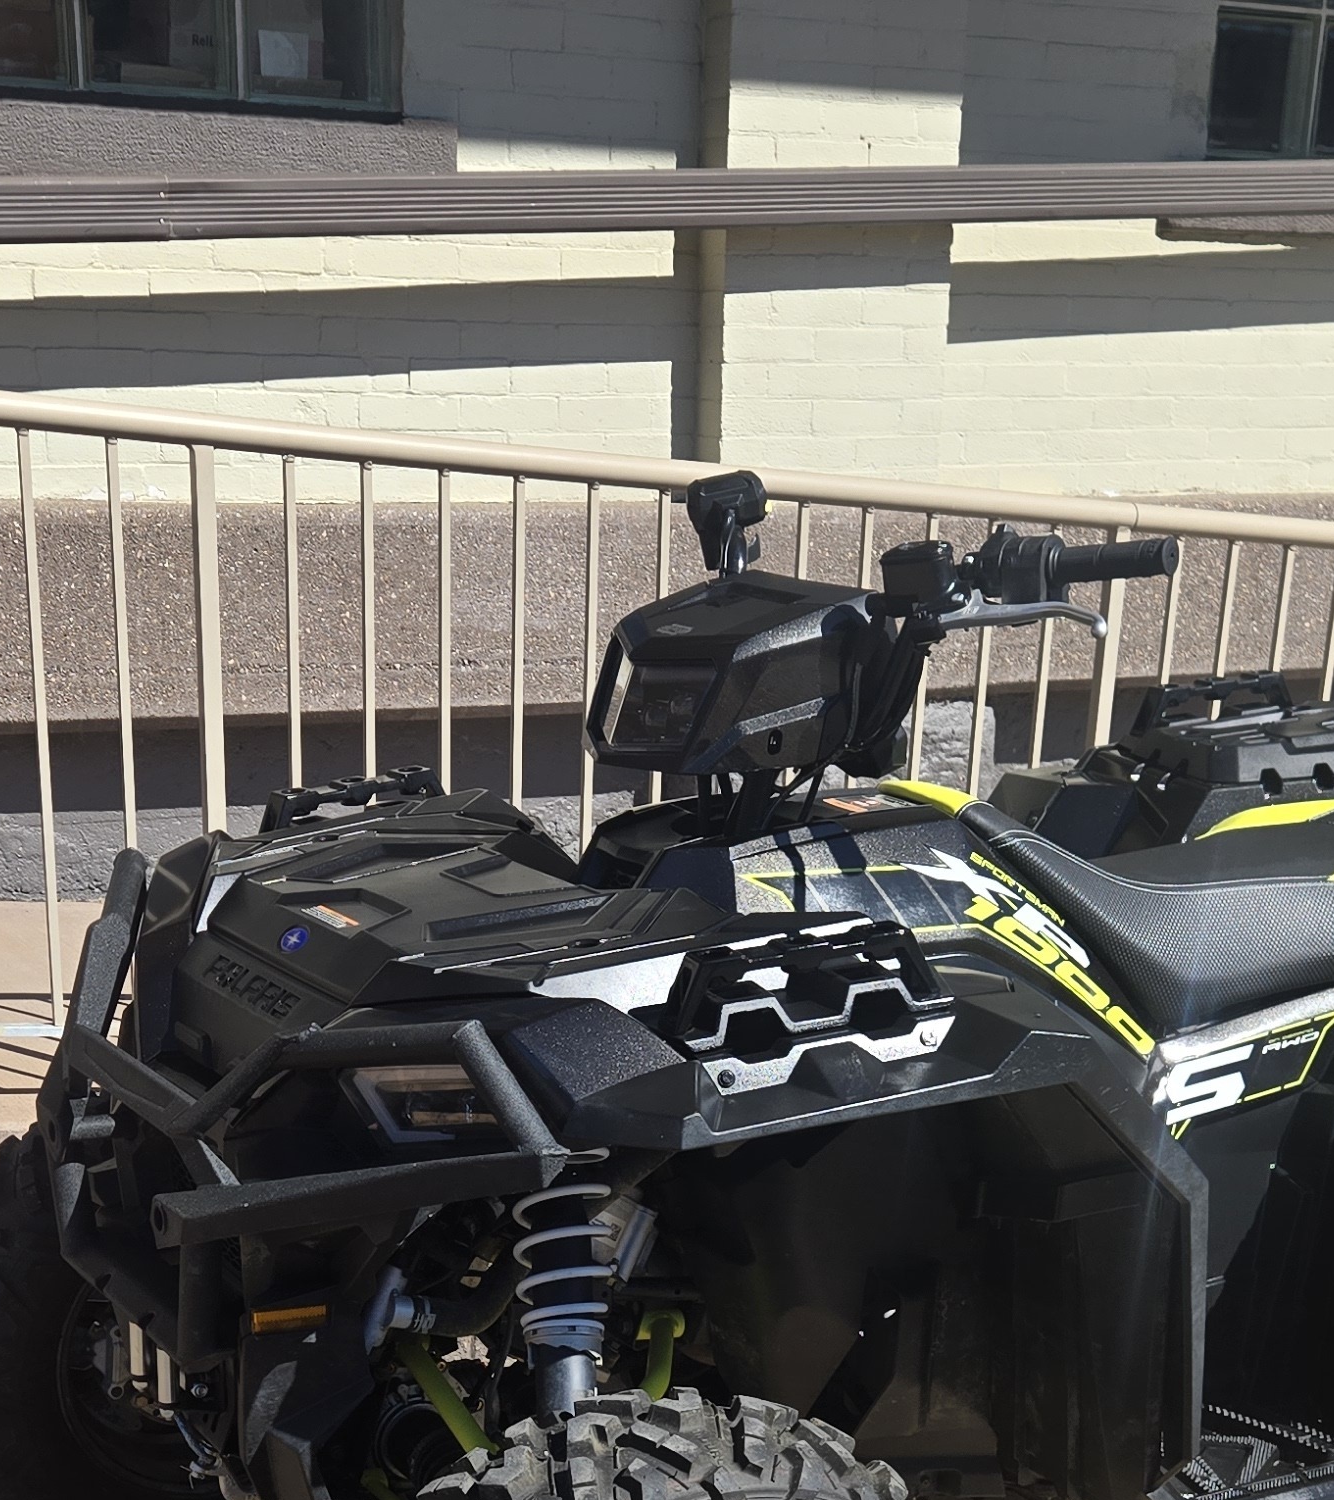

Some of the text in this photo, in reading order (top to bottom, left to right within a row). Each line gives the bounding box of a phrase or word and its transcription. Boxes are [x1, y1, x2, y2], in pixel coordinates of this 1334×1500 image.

[970, 852, 1065, 927] SPORTSMAN
[203, 954, 301, 1019] POLARIS
[964, 895, 1155, 1055] 1000
[1262, 1031, 1320, 1054] AWD
